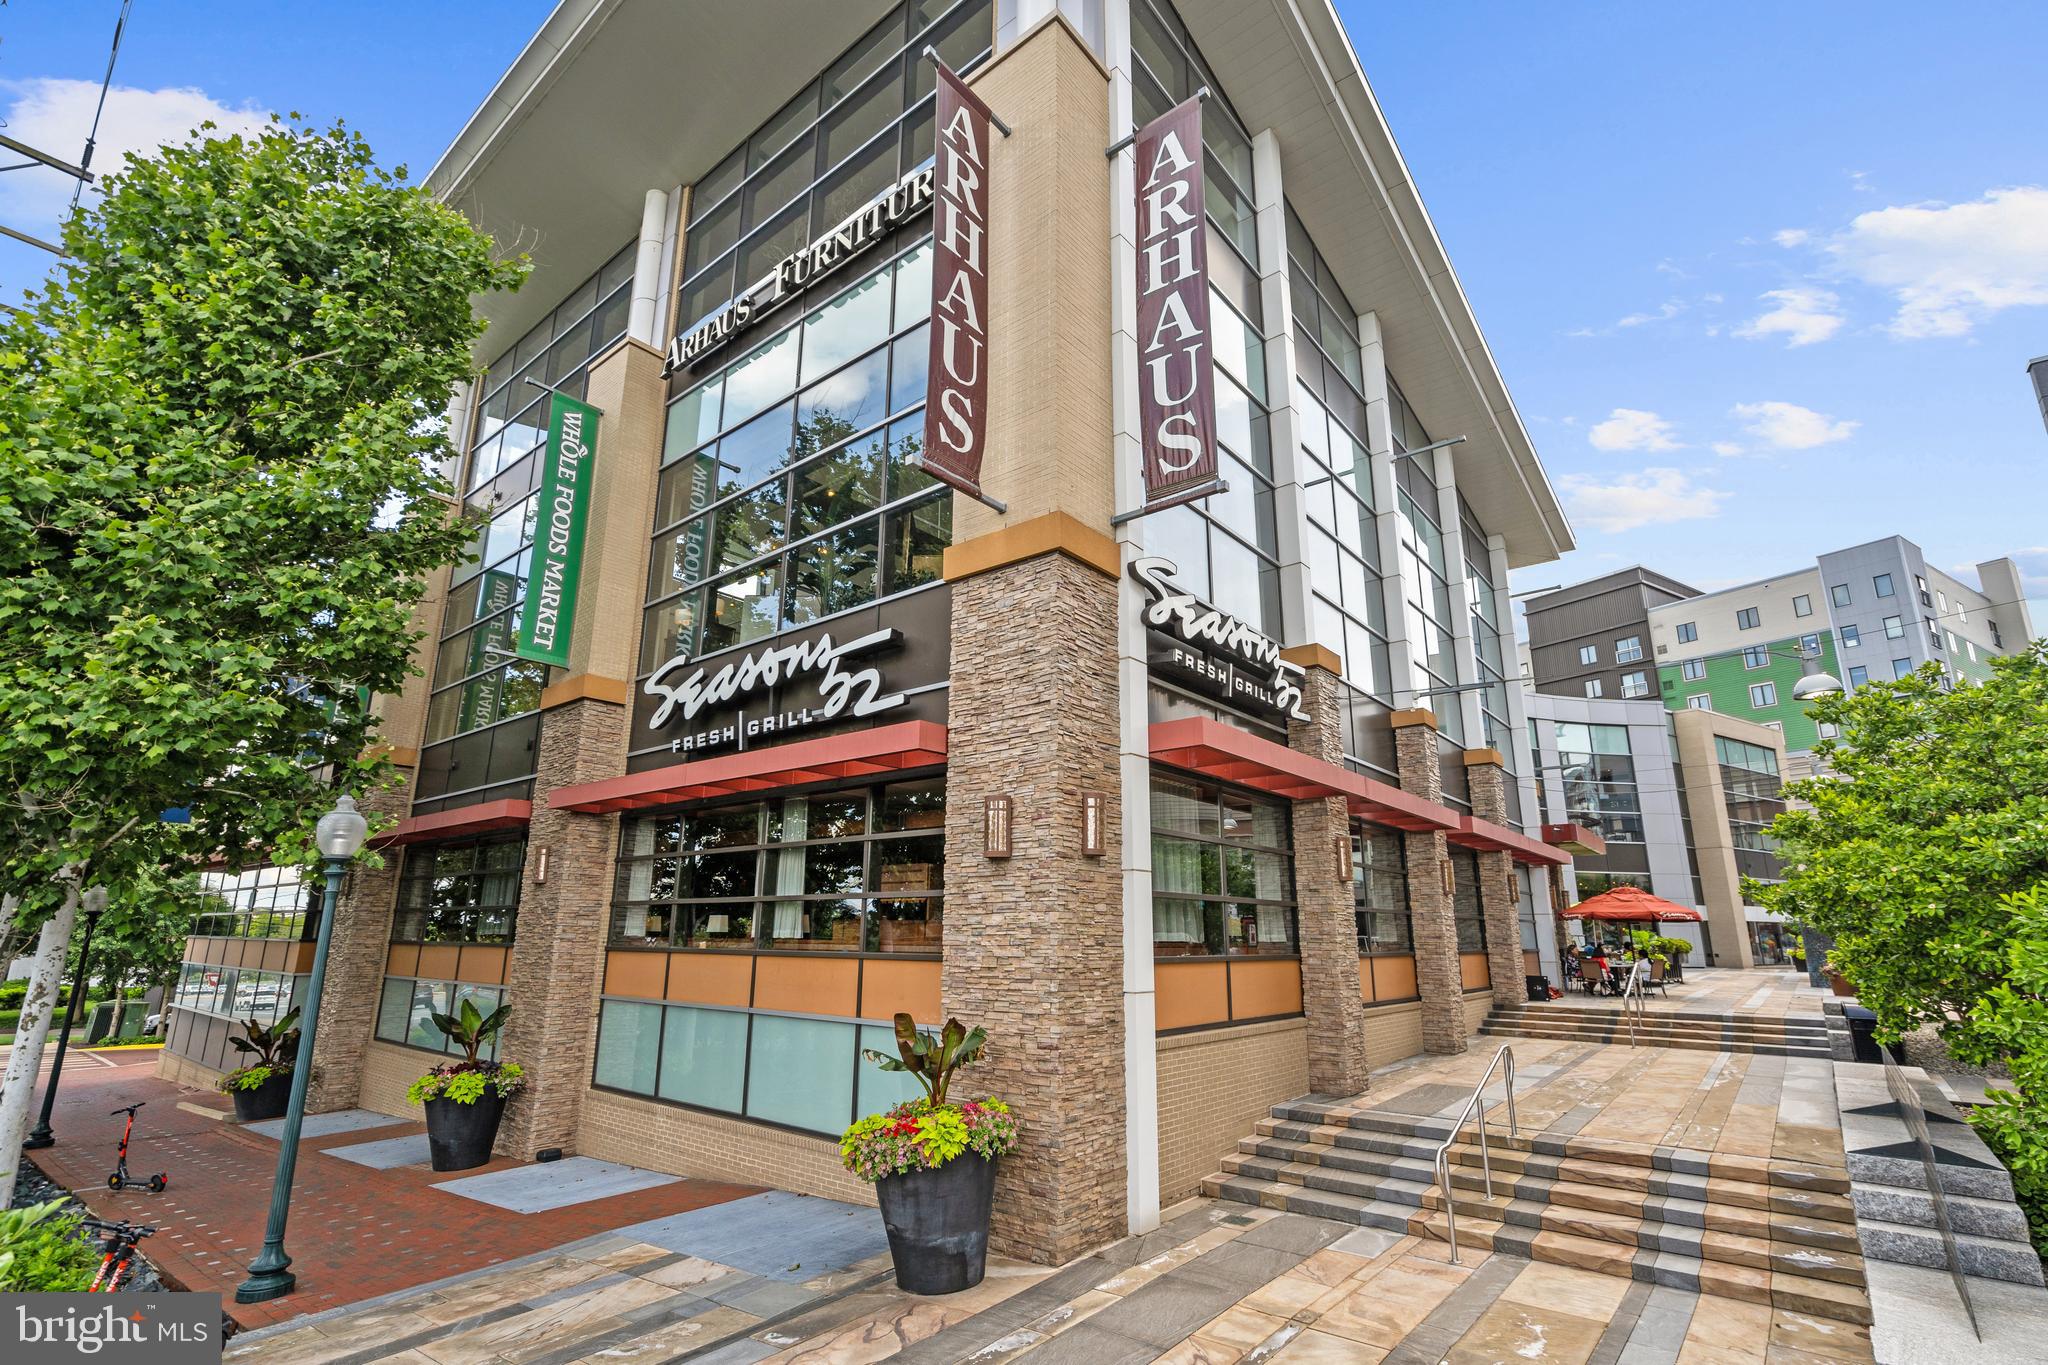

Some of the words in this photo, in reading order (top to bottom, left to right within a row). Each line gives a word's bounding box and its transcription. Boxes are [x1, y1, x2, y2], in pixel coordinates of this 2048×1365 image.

[660, 295, 751, 379] ARHAUS
[771, 168, 935, 304] FURNITUR
[938, 106, 985, 453] ARHAUS
[1142, 130, 1203, 477] ARHAUS
[558, 411, 588, 482] WHOLE
[549, 484, 574, 556] FOODS
[534, 558, 565, 650] MARKET
[644, 630, 848, 729] Seasons
[819, 652, 904, 717] 52
[1173, 649, 1227, 684] FRESH
[1235, 678, 1273, 704] GRILL
[672, 725, 735, 753] FRESH
[747, 708, 813, 736] GRILL
